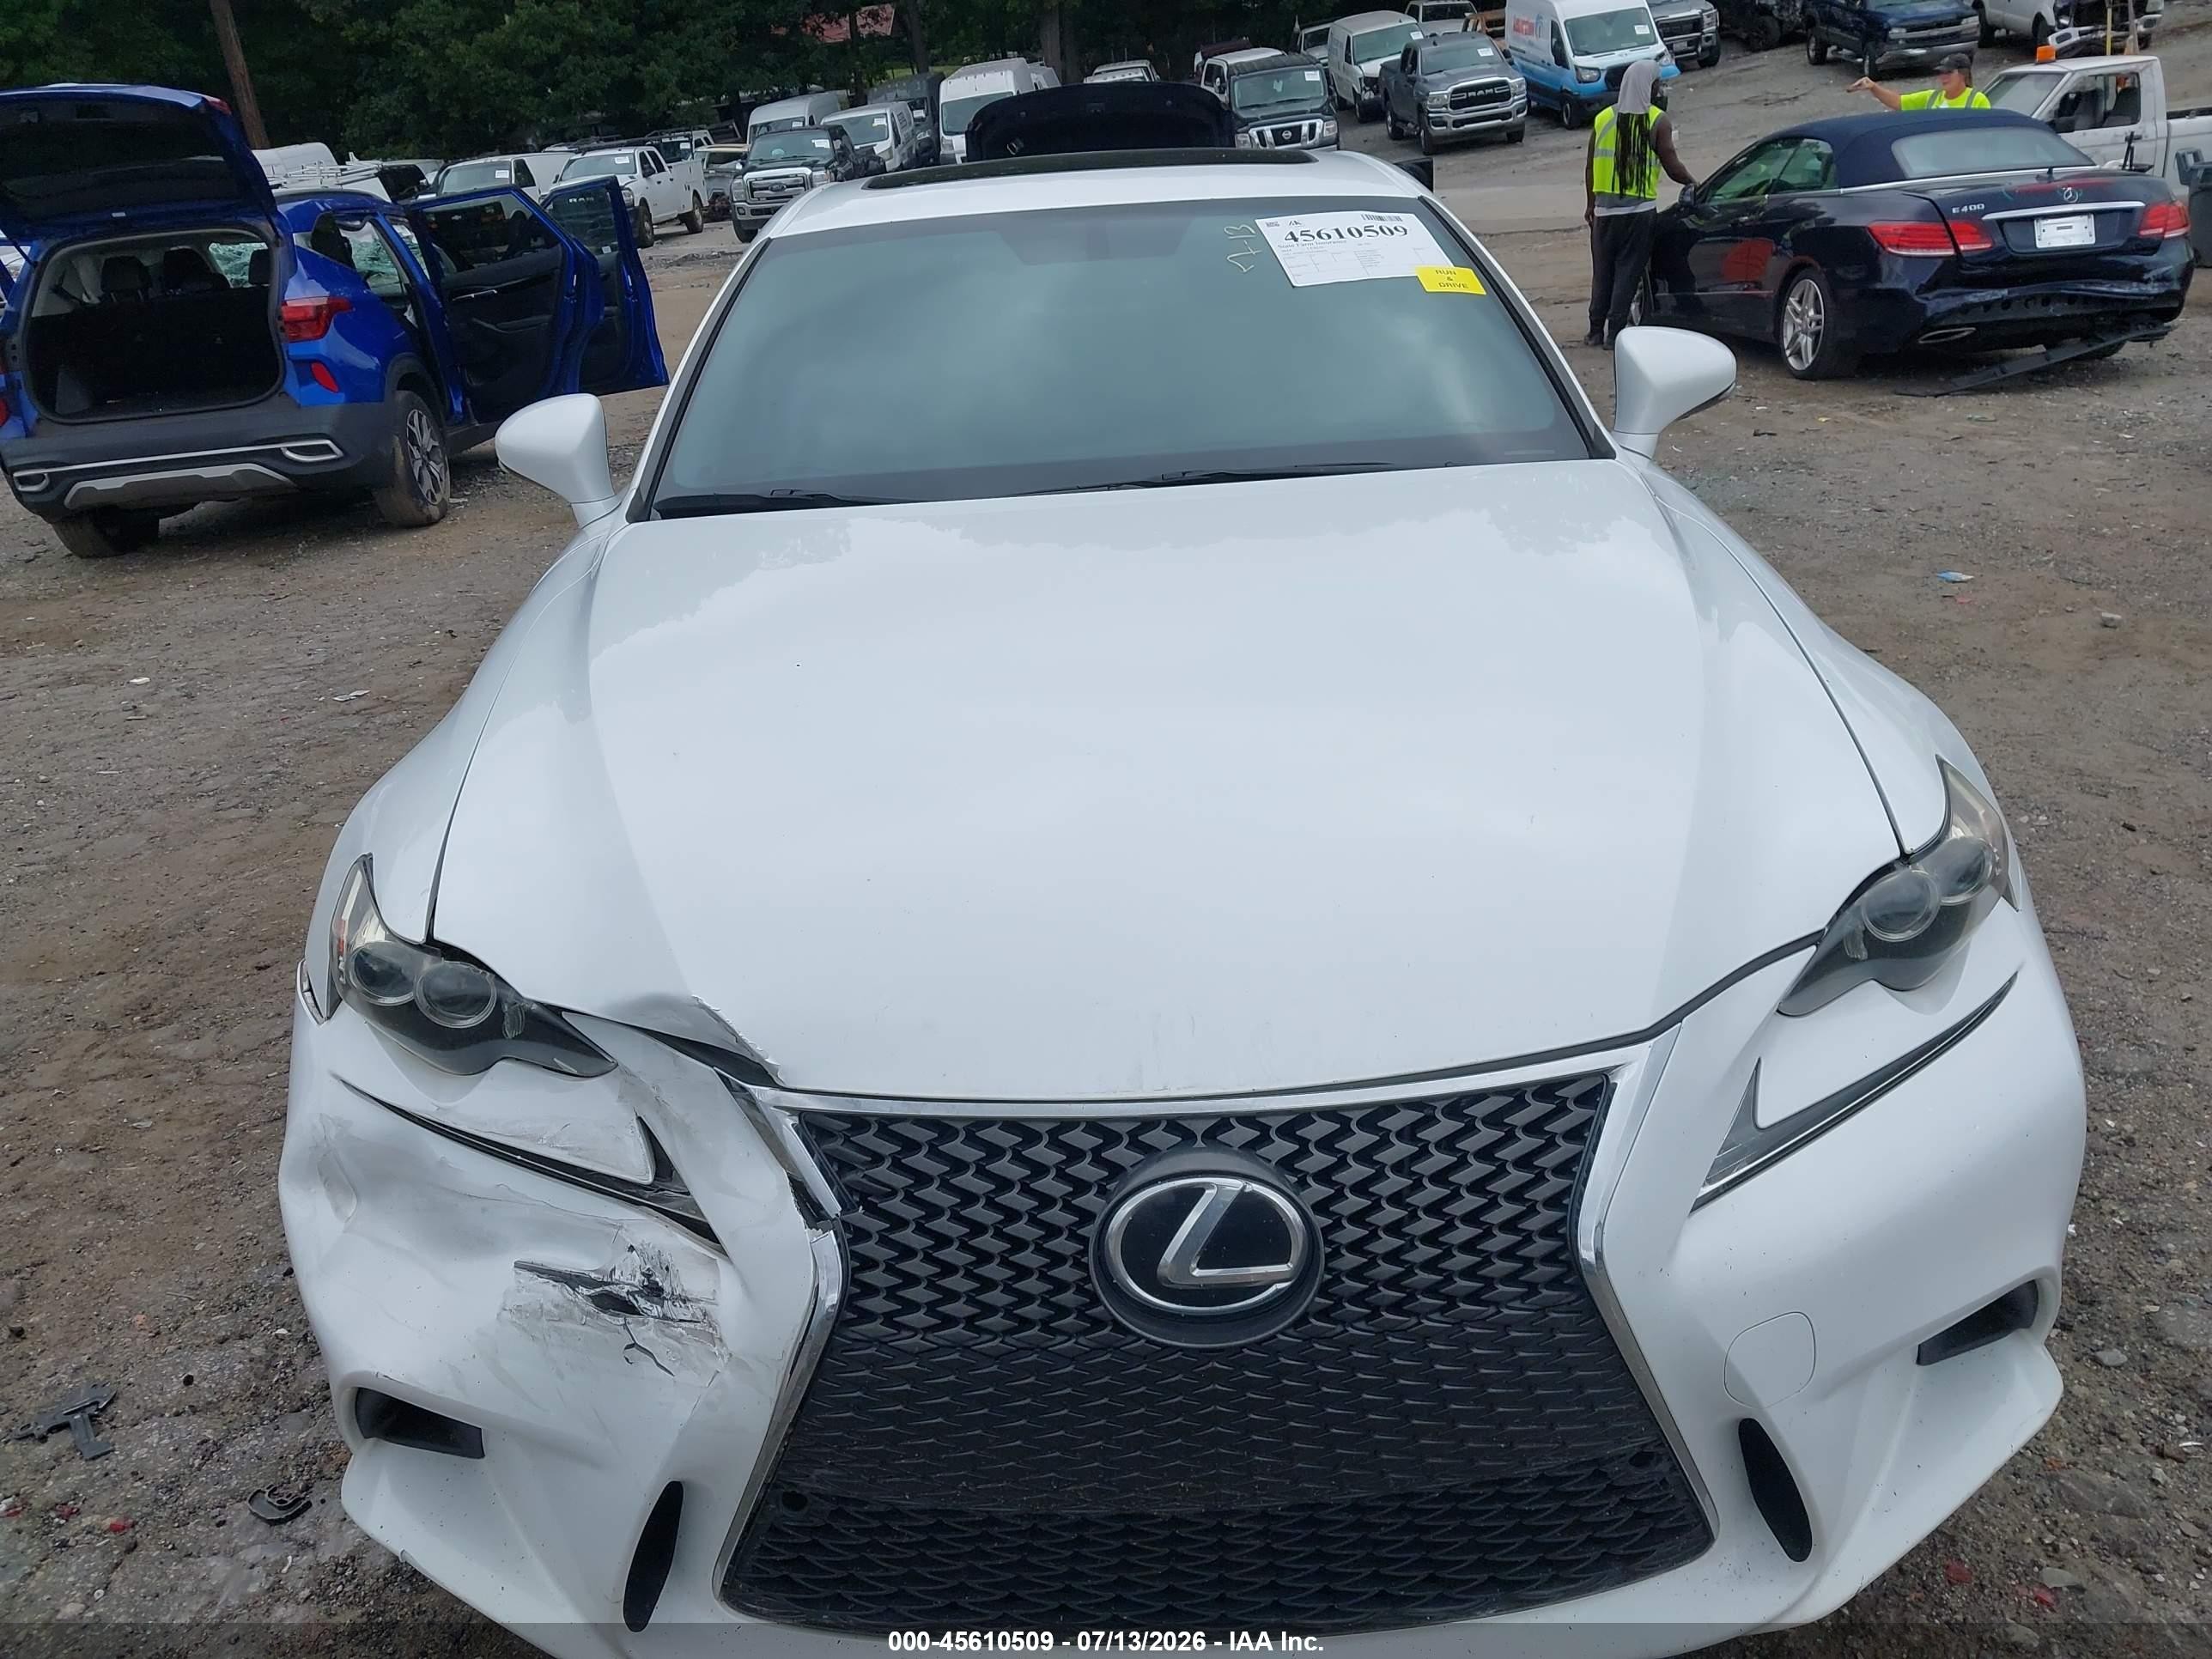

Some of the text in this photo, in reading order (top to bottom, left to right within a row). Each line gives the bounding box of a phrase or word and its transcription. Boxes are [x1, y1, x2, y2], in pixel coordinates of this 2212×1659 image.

[1468, 88, 1494, 97] RAM
[1960, 203, 1985, 212] 400
[1285, 224, 1408, 242] 45610509
